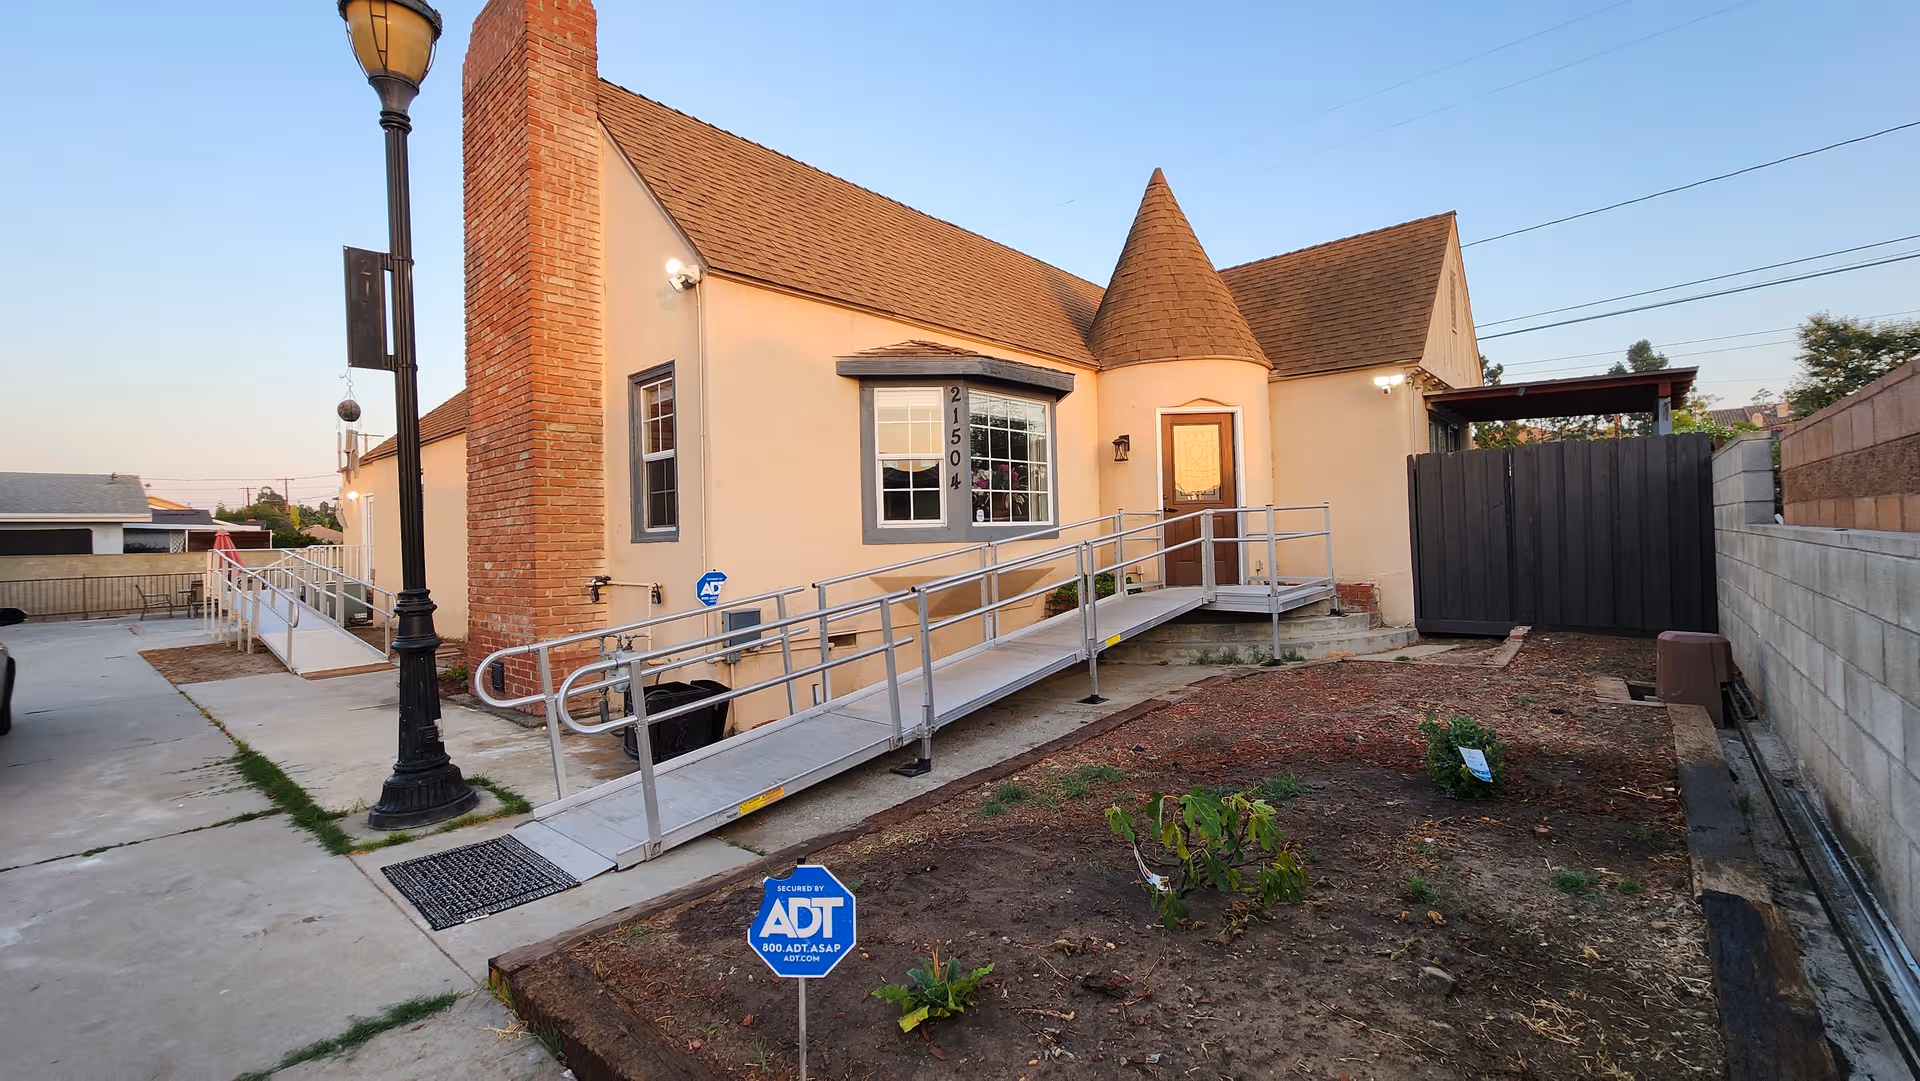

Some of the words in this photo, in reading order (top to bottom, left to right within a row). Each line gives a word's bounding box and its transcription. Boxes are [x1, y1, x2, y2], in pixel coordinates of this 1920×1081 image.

[950, 386, 961, 490] 21504
[759, 897, 844, 938] ADT
[762, 943, 841, 953] 800.ADT.ASAP
